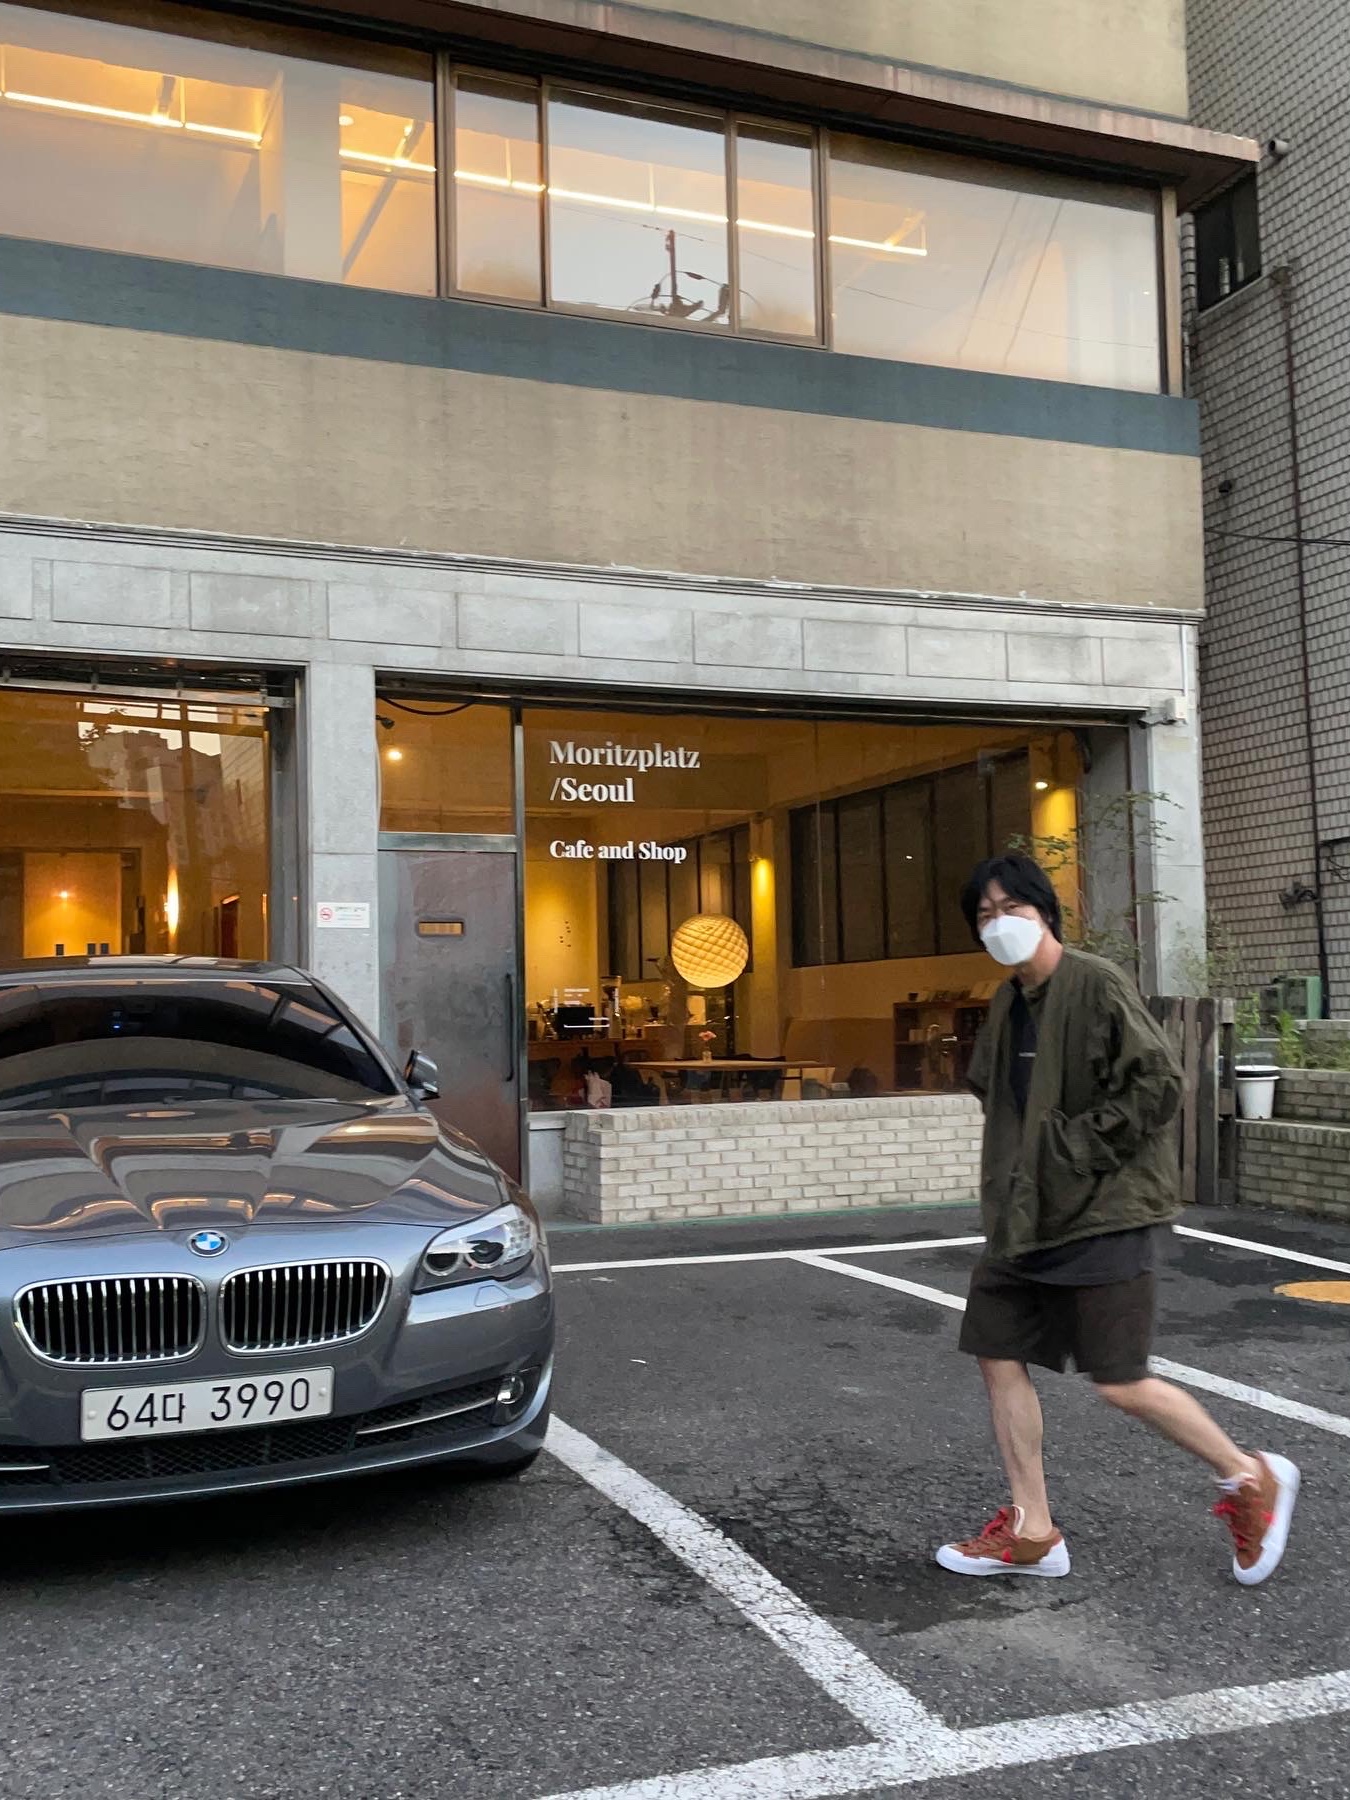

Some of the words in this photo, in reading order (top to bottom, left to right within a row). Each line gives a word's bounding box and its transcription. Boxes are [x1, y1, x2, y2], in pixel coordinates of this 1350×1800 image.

[549, 740, 701, 773] Moritzplatz
[549, 777, 636, 803] /Seoul
[549, 840, 595, 859] Cafe
[598, 841, 635, 860] and
[638, 841, 687, 864] Shop
[107, 1392, 187, 1431] 64다
[210, 1377, 310, 1422] 3990
